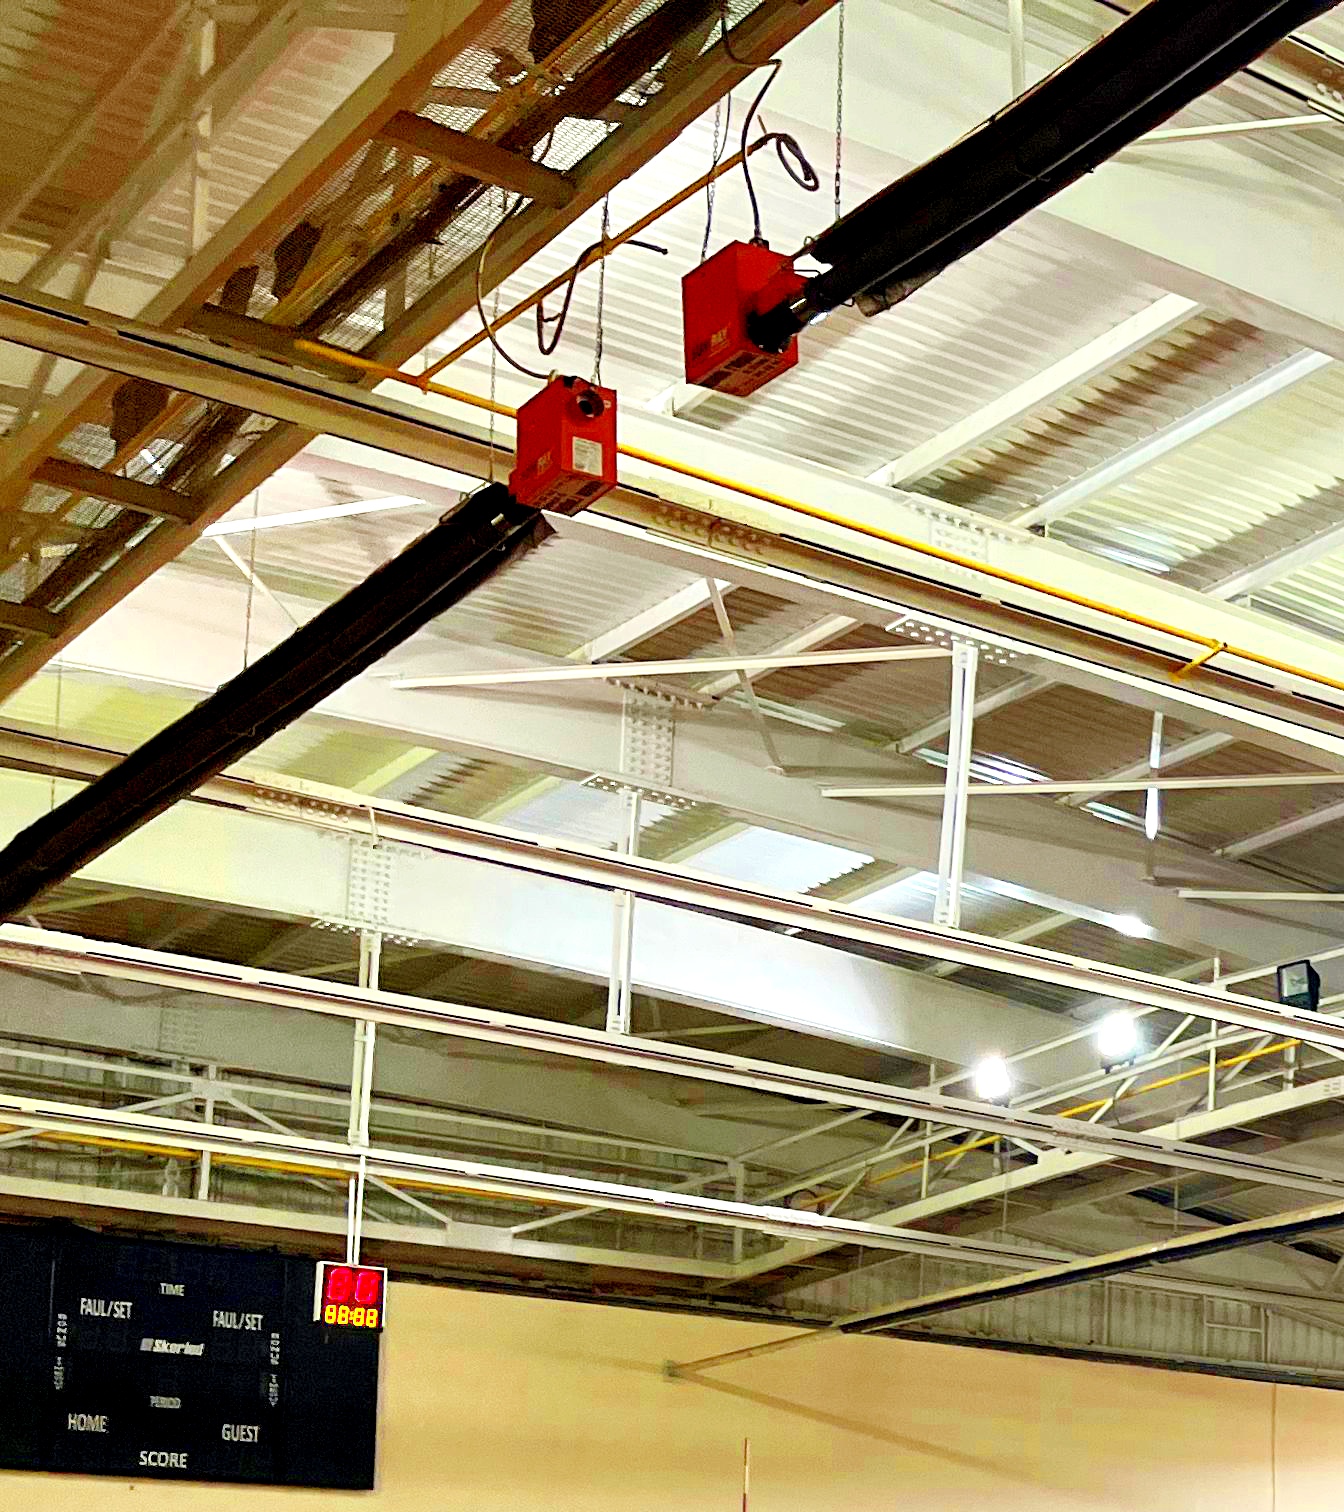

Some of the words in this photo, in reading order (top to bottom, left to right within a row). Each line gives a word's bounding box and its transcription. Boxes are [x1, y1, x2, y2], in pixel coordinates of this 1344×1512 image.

[160, 1282, 185, 1297] TIME
[79, 1297, 133, 1320] FAUL/SET
[212, 1310, 264, 1331] FAUL/SET
[67, 1412, 108, 1434] HOME
[221, 1423, 261, 1444] GUEST
[139, 1450, 188, 1469] SCORE
